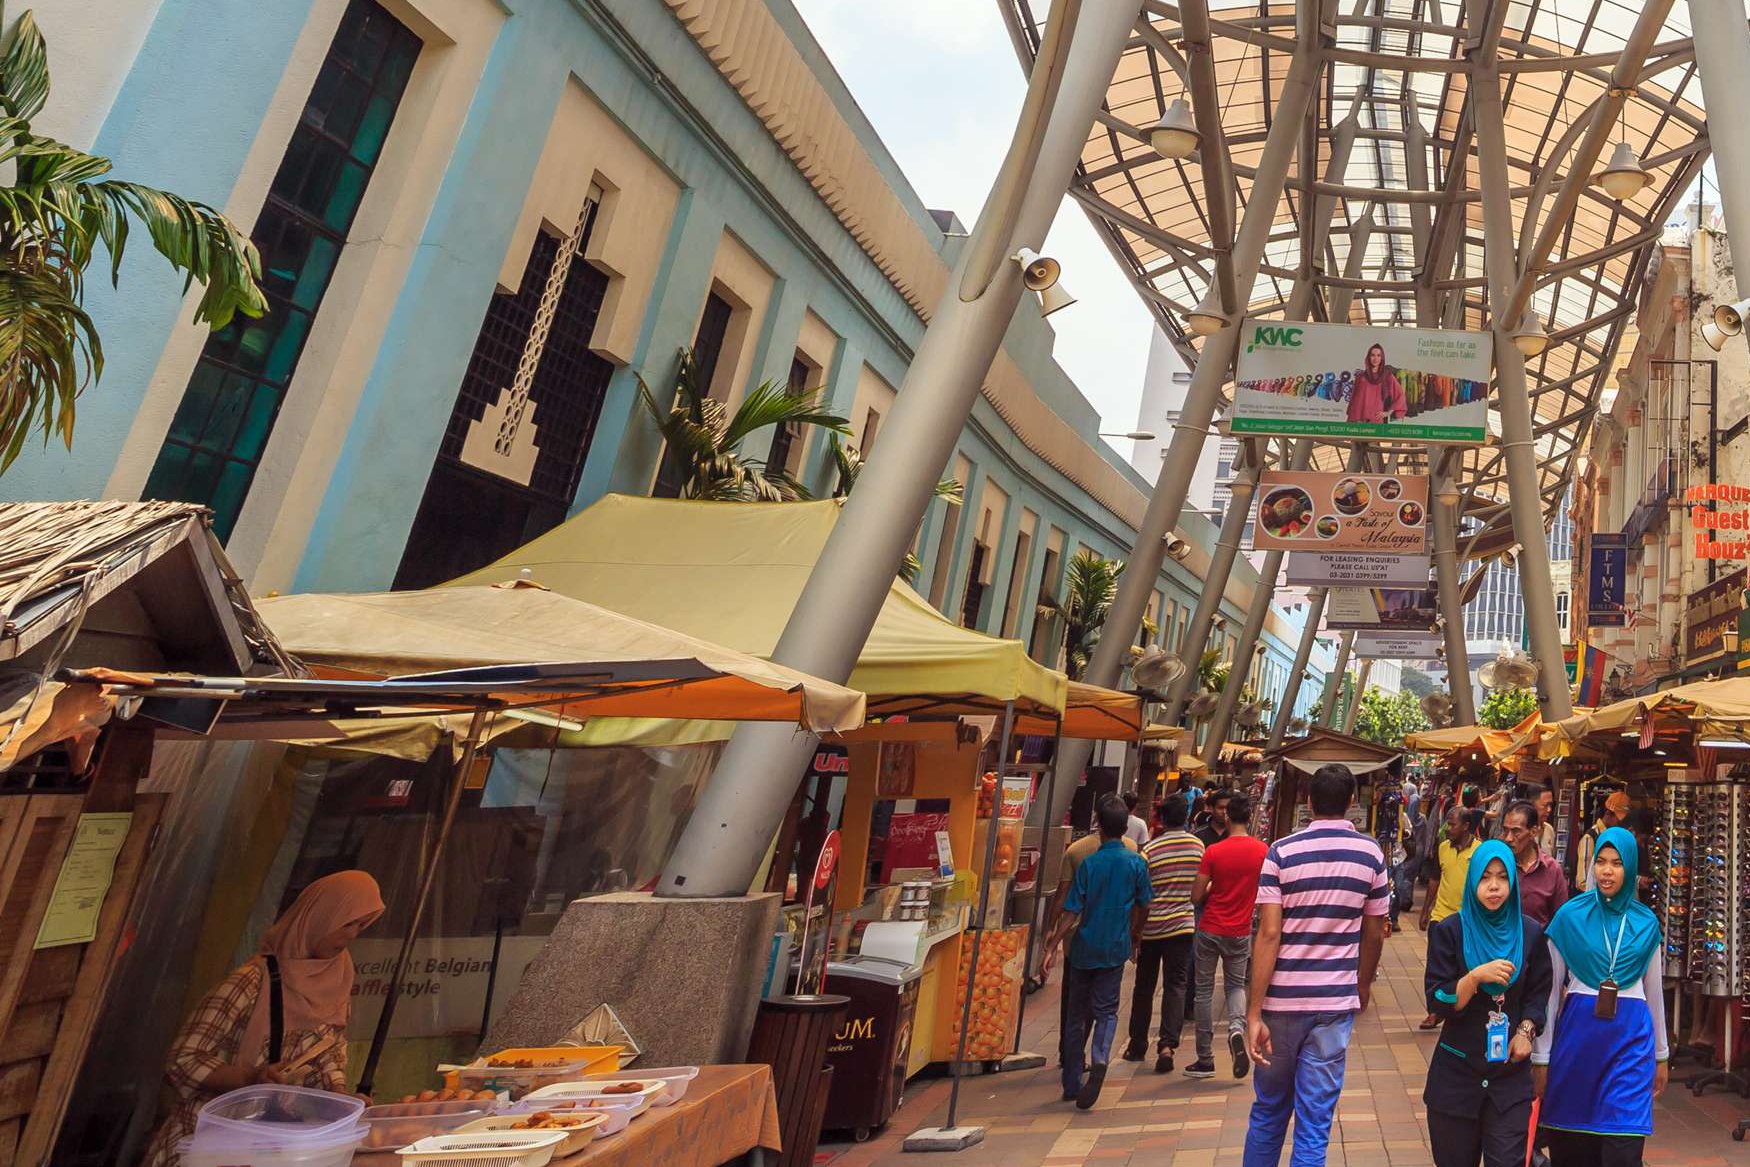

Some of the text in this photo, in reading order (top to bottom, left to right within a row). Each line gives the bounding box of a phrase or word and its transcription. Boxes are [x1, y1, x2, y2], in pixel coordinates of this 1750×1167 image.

[1255, 326, 1304, 347] KWC
[1691, 504, 1749, 531] Guest
[1360, 530, 1422, 548] Malaysia
[1320, 555, 1401, 564] FOR LEASING ENQUIRIES
